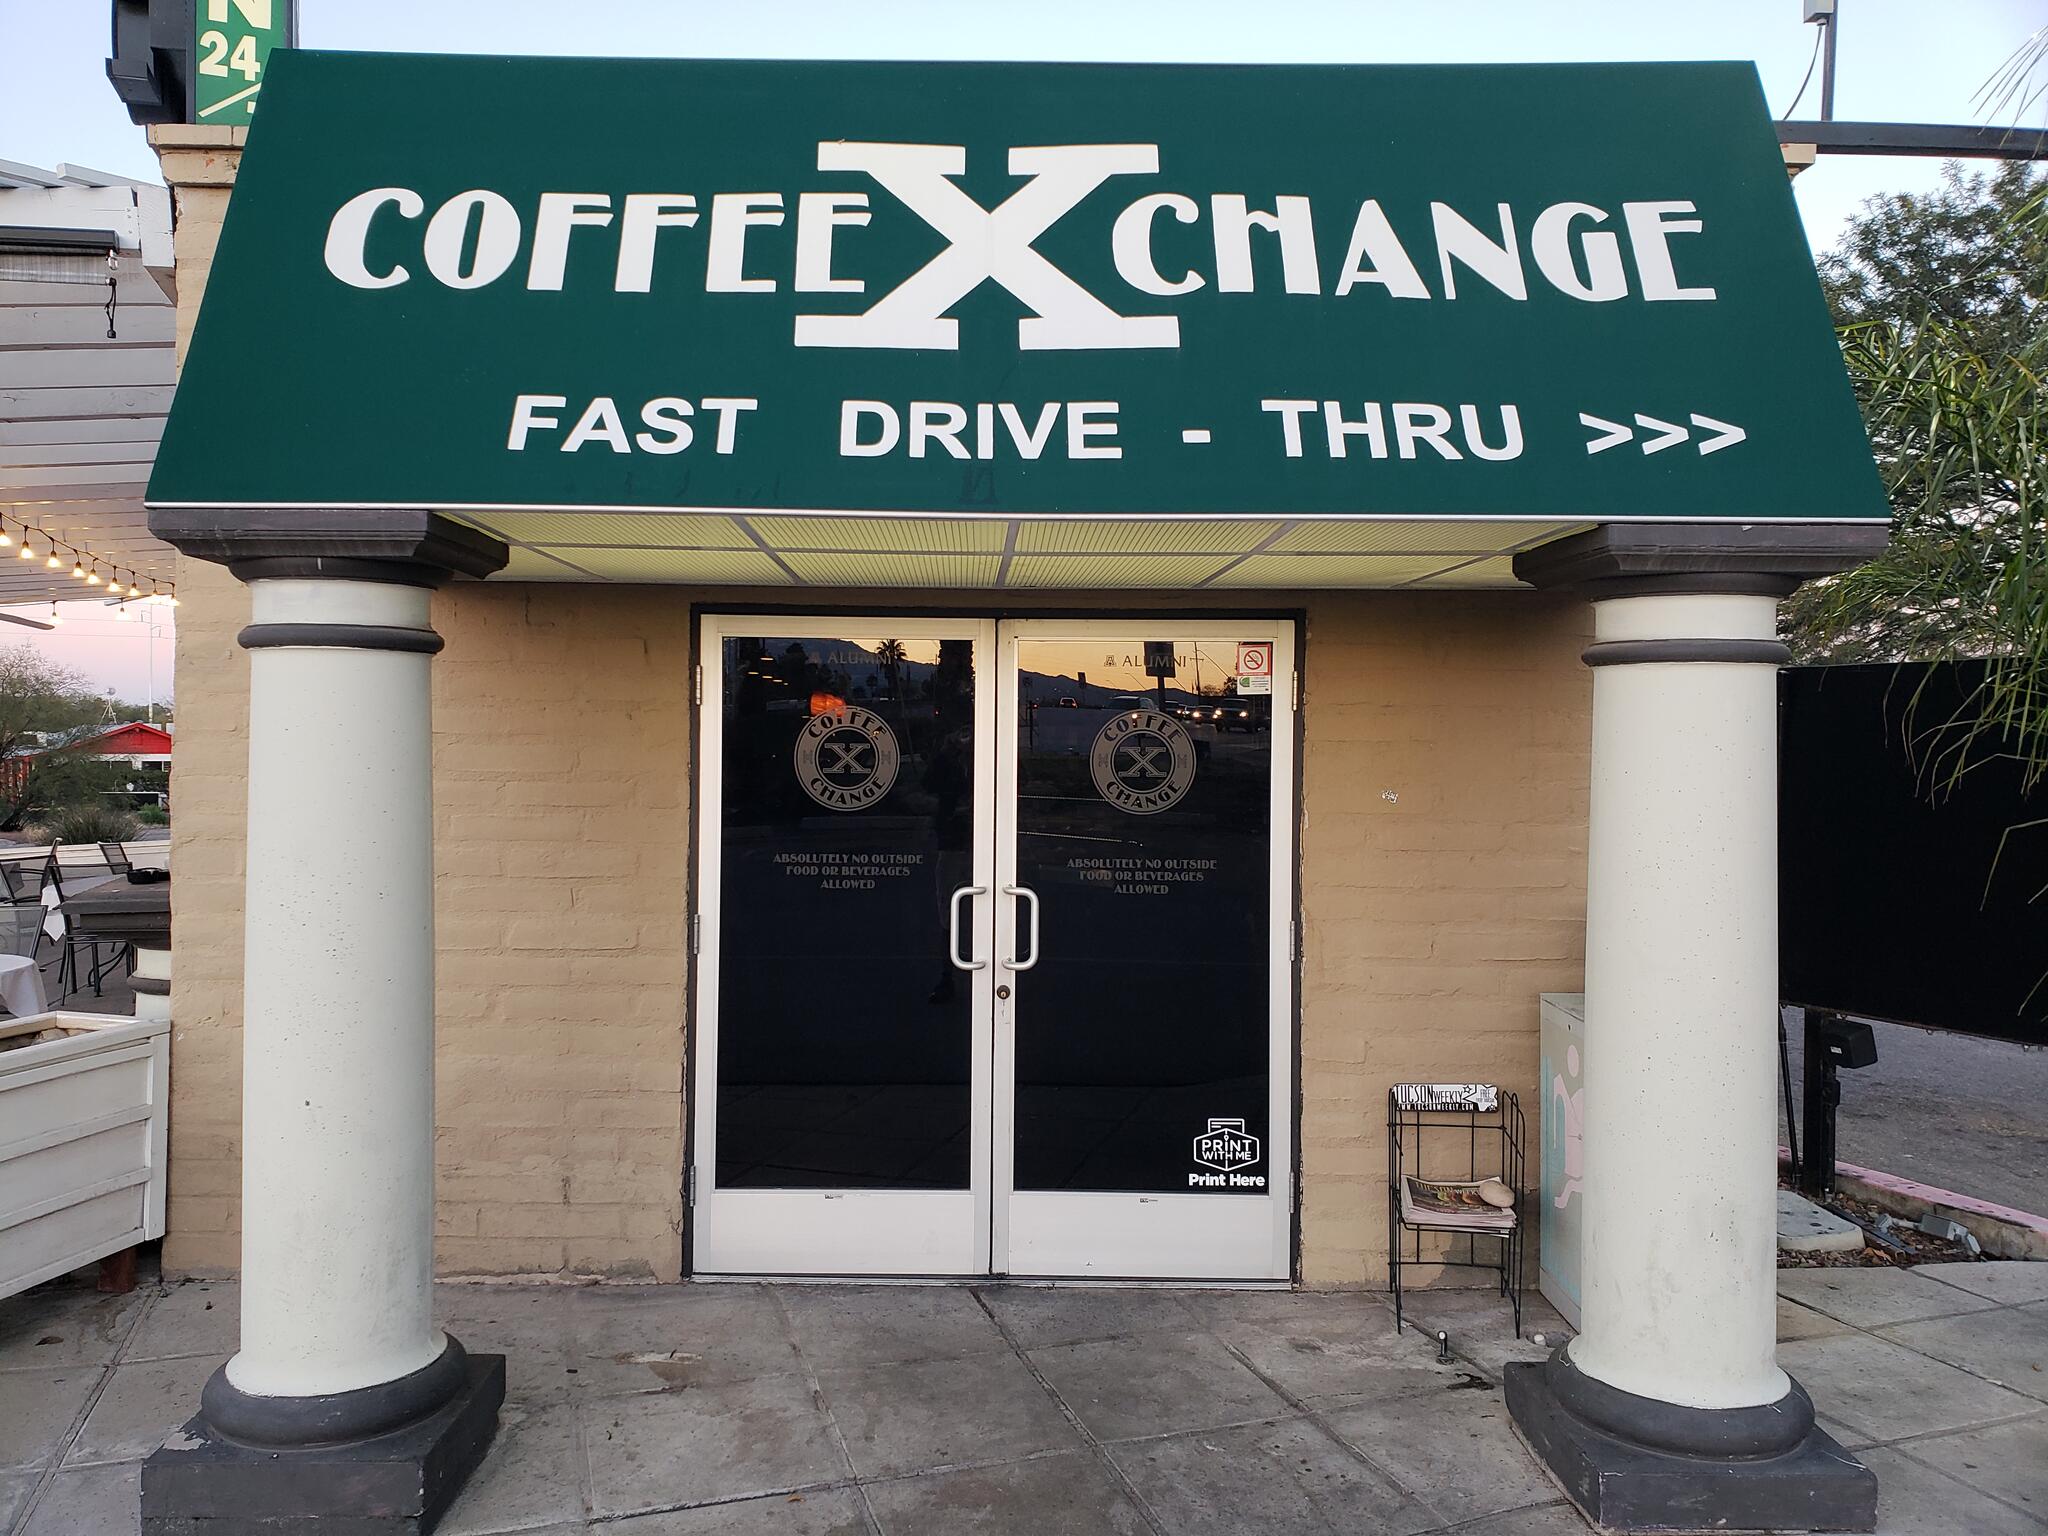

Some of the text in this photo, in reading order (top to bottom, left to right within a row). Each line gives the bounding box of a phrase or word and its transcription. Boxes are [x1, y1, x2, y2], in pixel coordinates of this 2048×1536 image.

[323, 187, 872, 293] COFFEE
[1111, 193, 1718, 303] CHANGE
[506, 394, 759, 455] FAST
[839, 401, 1123, 460] DRIVE
[1261, 400, 1526, 462] THRU
[827, 652, 892, 665] ALUMNI
[1122, 655, 1187, 667] ALUMNI
[1103, 714, 1184, 745] COFFEE
[822, 742, 872, 774] X
[1117, 746, 1167, 778] X
[810, 776, 887, 806] CHANGE
[1105, 780, 1183, 810] CHANGE
[773, 853, 924, 865] ABSOLUTELY NO OUTSIDE
[1067, 858, 1217, 870] ABSOLUTELY NO OUTSIDE
[786, 865, 911, 877] FOOD OR BEVERAGES
[1079, 870, 1205, 882] FOOD OR BEVERAGES
[820, 879, 876, 889] ALLOWED
[1114, 884, 1169, 895] ALLOWED
[1394, 1084, 1434, 1104] TUCSON
[1433, 1090, 1464, 1104] WEEKLY
[1202, 1151, 1252, 1160] WITH ME
[1188, 1173, 1266, 1187] Print Here
